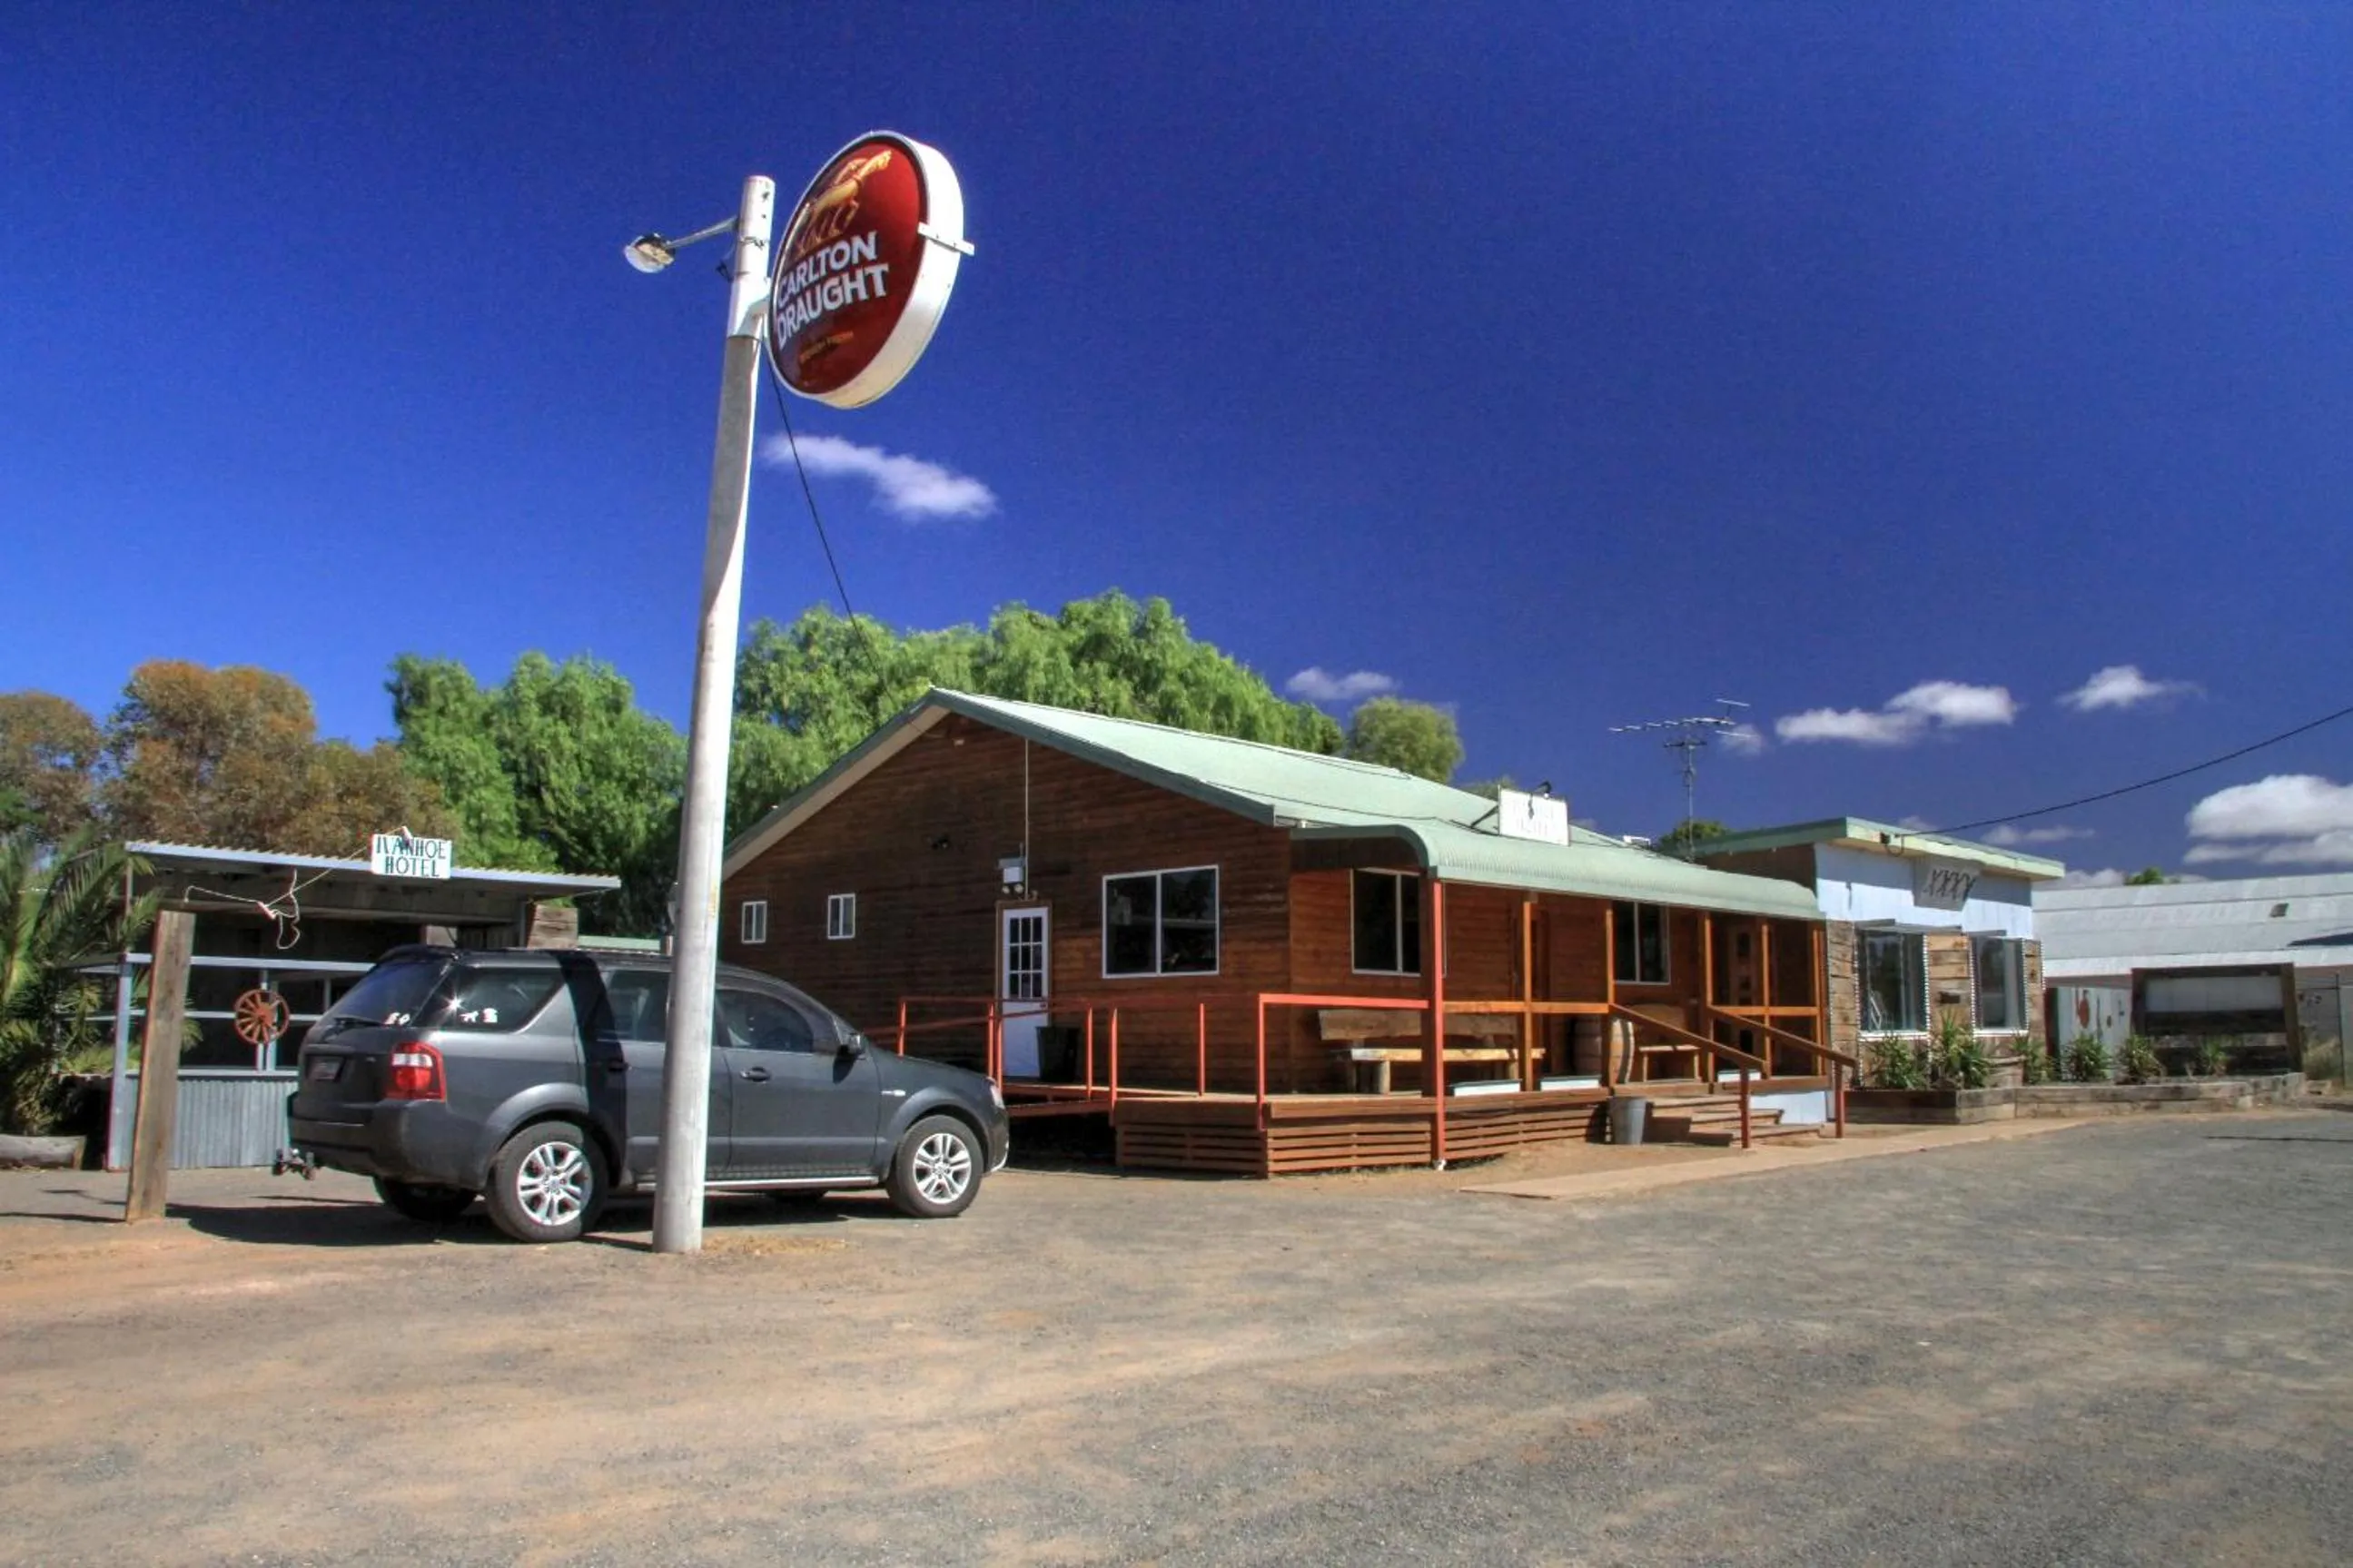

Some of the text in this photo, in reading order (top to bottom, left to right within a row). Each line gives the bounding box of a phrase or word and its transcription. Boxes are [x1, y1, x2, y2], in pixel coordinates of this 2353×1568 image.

[776, 231, 877, 309] CARLTON
[776, 264, 889, 351] DRAUGHT
[376, 834, 447, 859] IVANHOE
[385, 855, 440, 877] HOTEL
